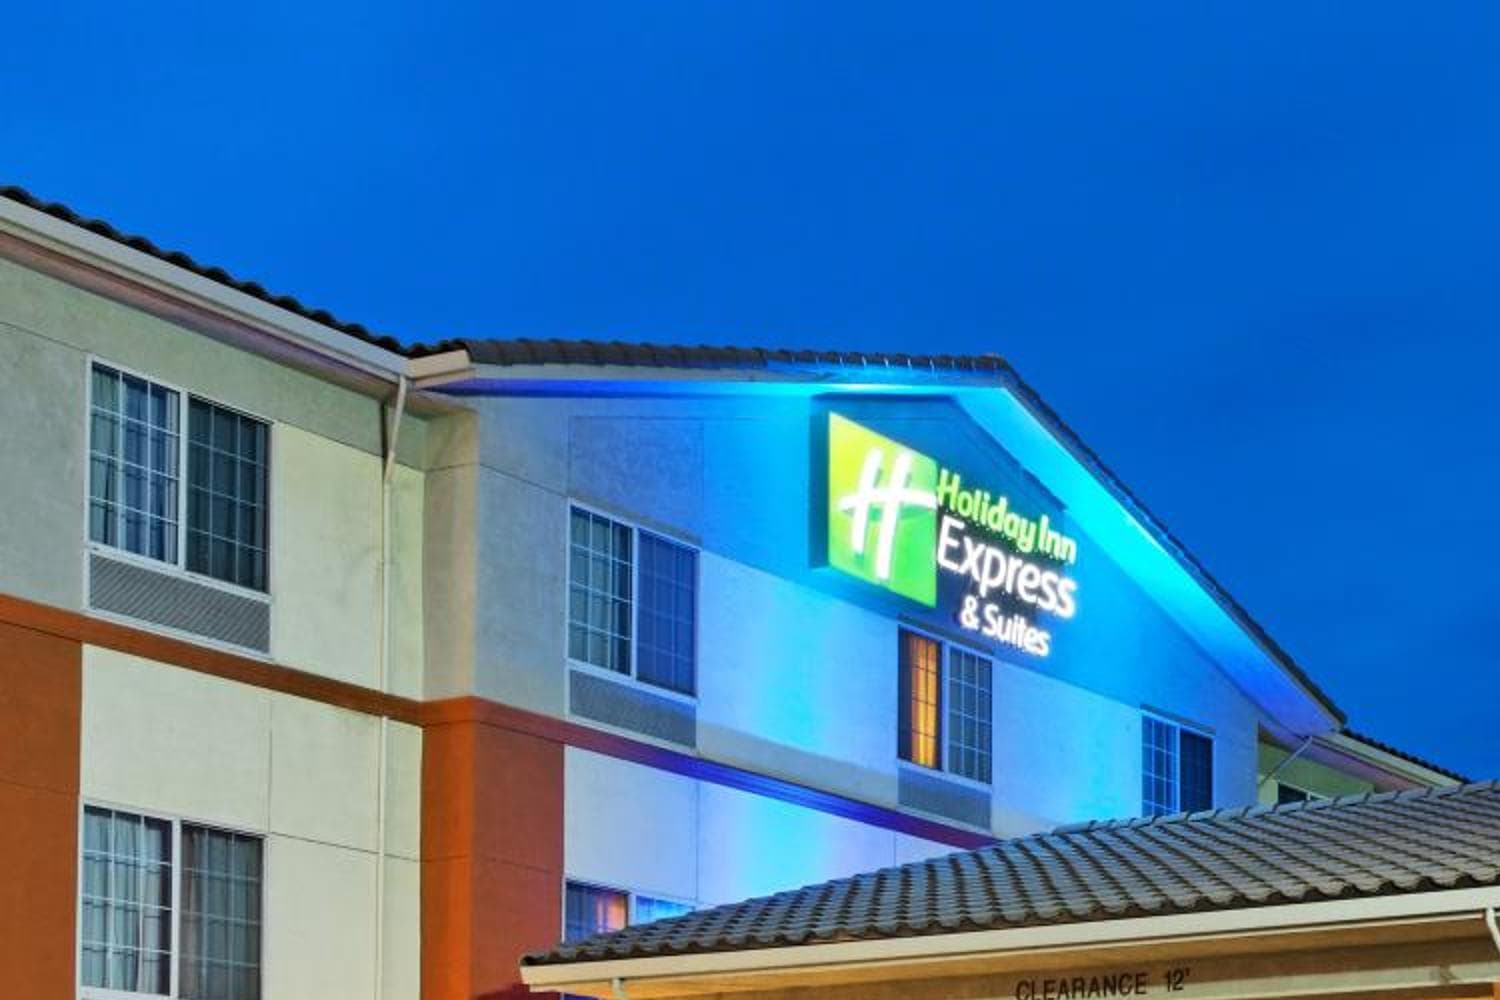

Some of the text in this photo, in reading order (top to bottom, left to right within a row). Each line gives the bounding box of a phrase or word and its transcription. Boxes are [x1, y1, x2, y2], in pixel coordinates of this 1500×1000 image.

[937, 468, 1077, 565] Holiday Inn
[937, 515, 1078, 619] Express
[960, 595, 1050, 656] & Suites
